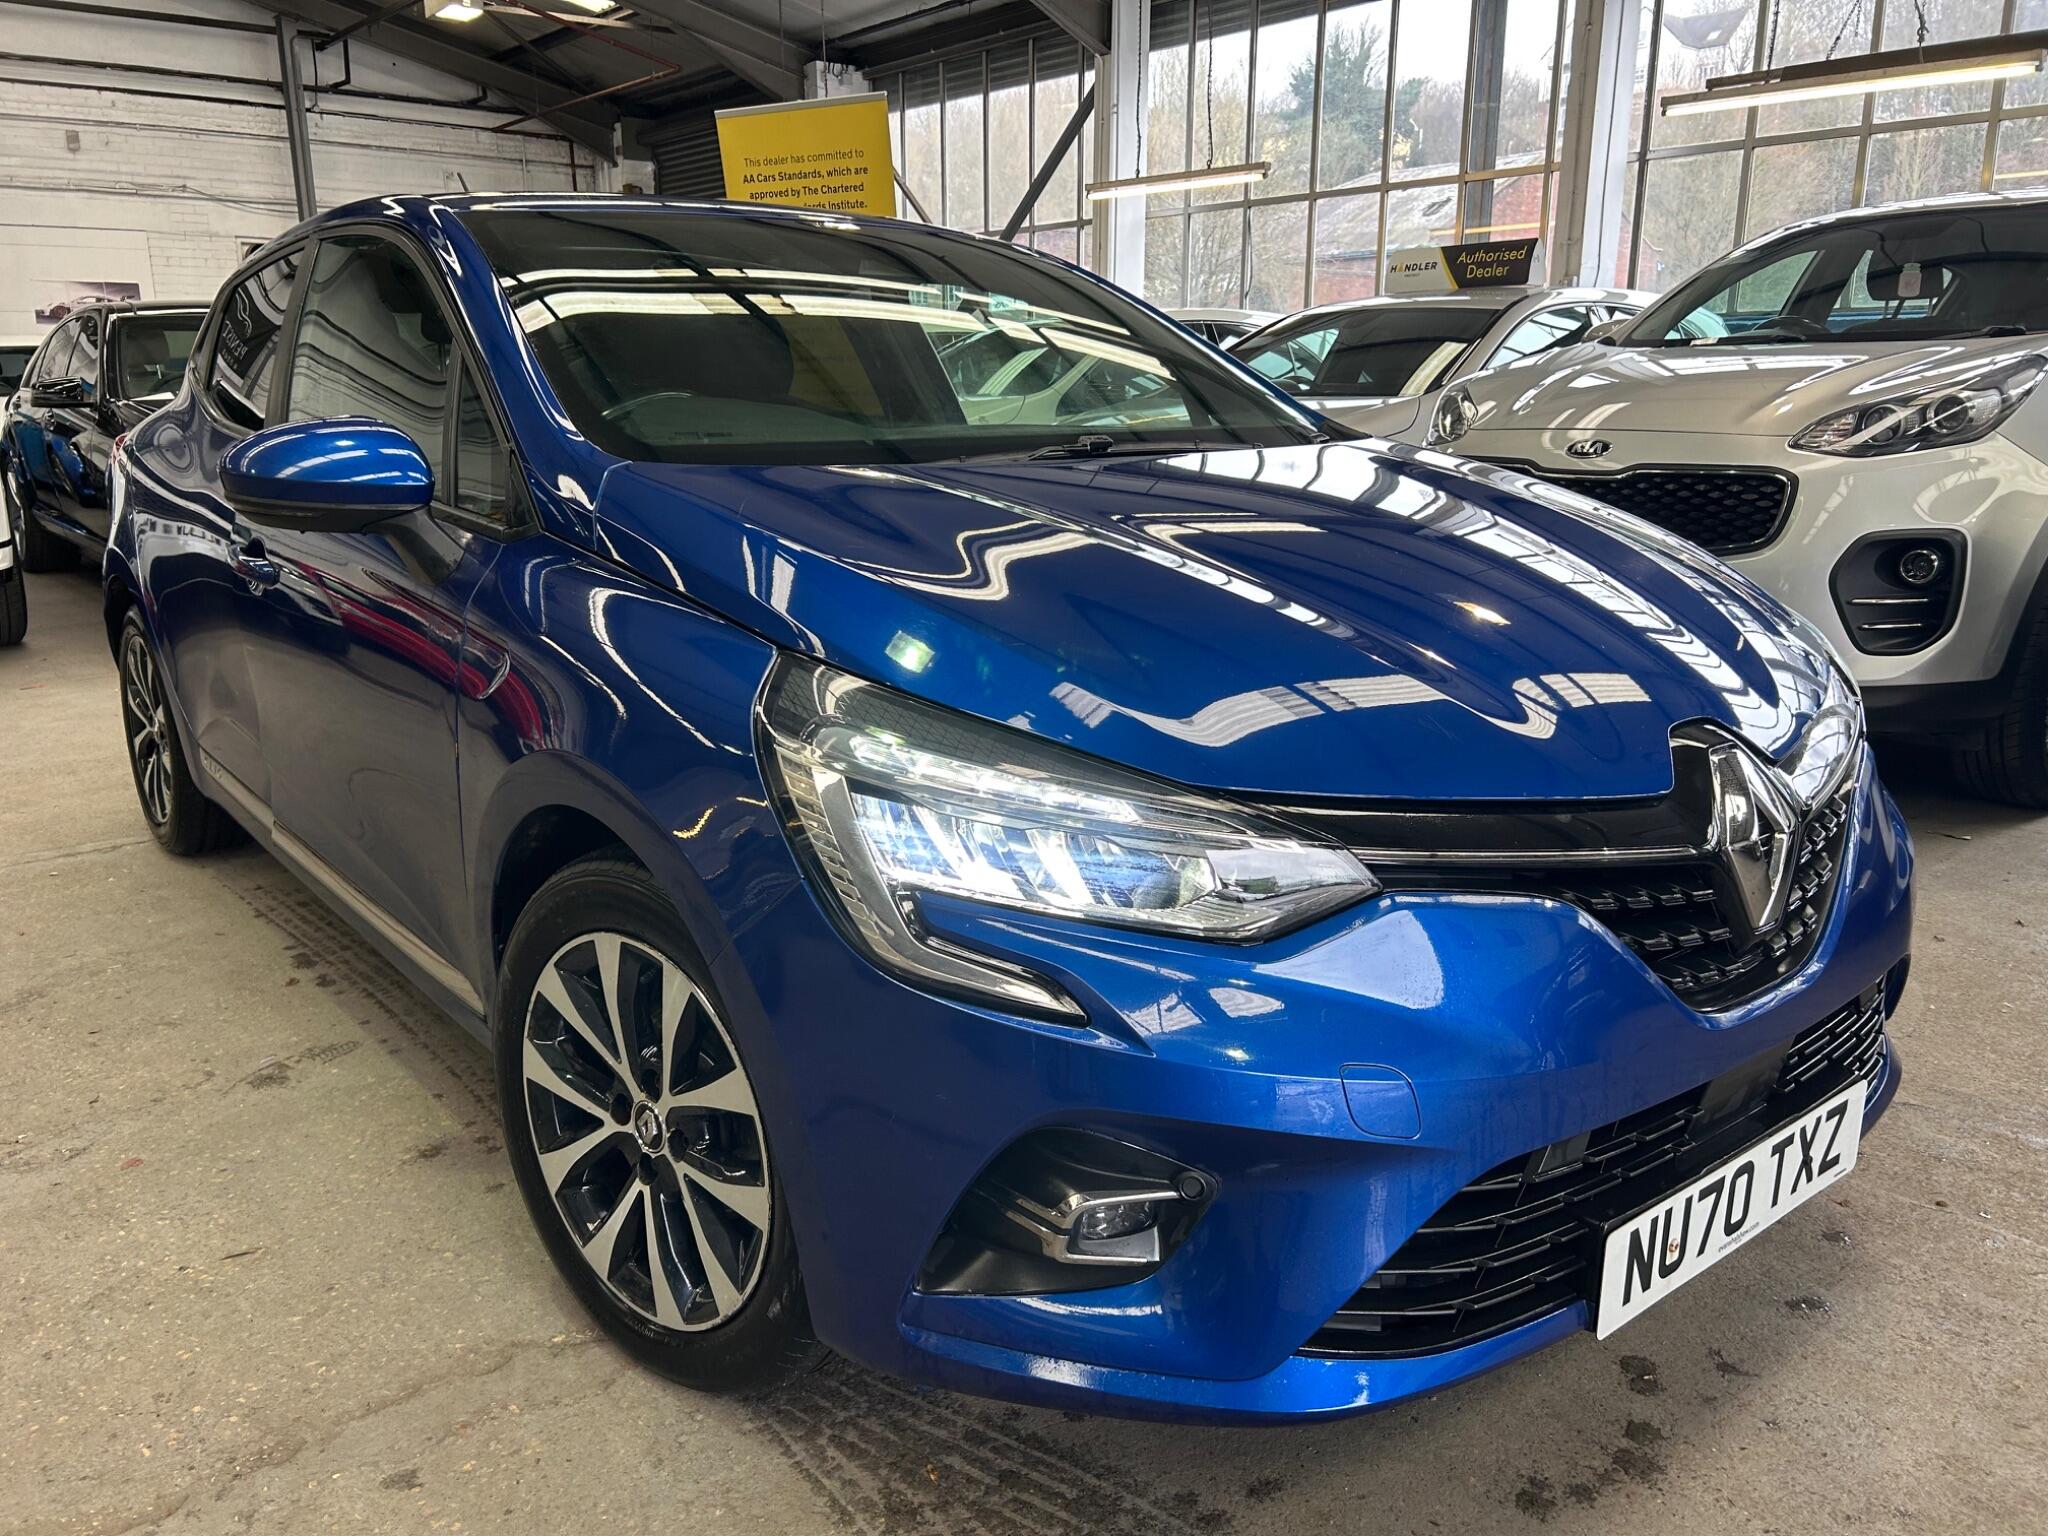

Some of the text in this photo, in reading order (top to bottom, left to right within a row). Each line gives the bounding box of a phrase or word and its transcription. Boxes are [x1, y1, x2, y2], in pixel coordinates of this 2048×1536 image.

[744, 149, 864, 168] This dealer has committed to
[743, 166, 868, 184] AA Cars Standards, which are
[749, 182, 864, 200] approved by The Chartered
[829, 199, 868, 210] Institute.
[1457, 246, 1527, 264] Authorised
[1467, 262, 1510, 279] Dealer
[1570, 441, 1603, 454] KIA
[1622, 1098, 1849, 1307] NU70 TXZ
